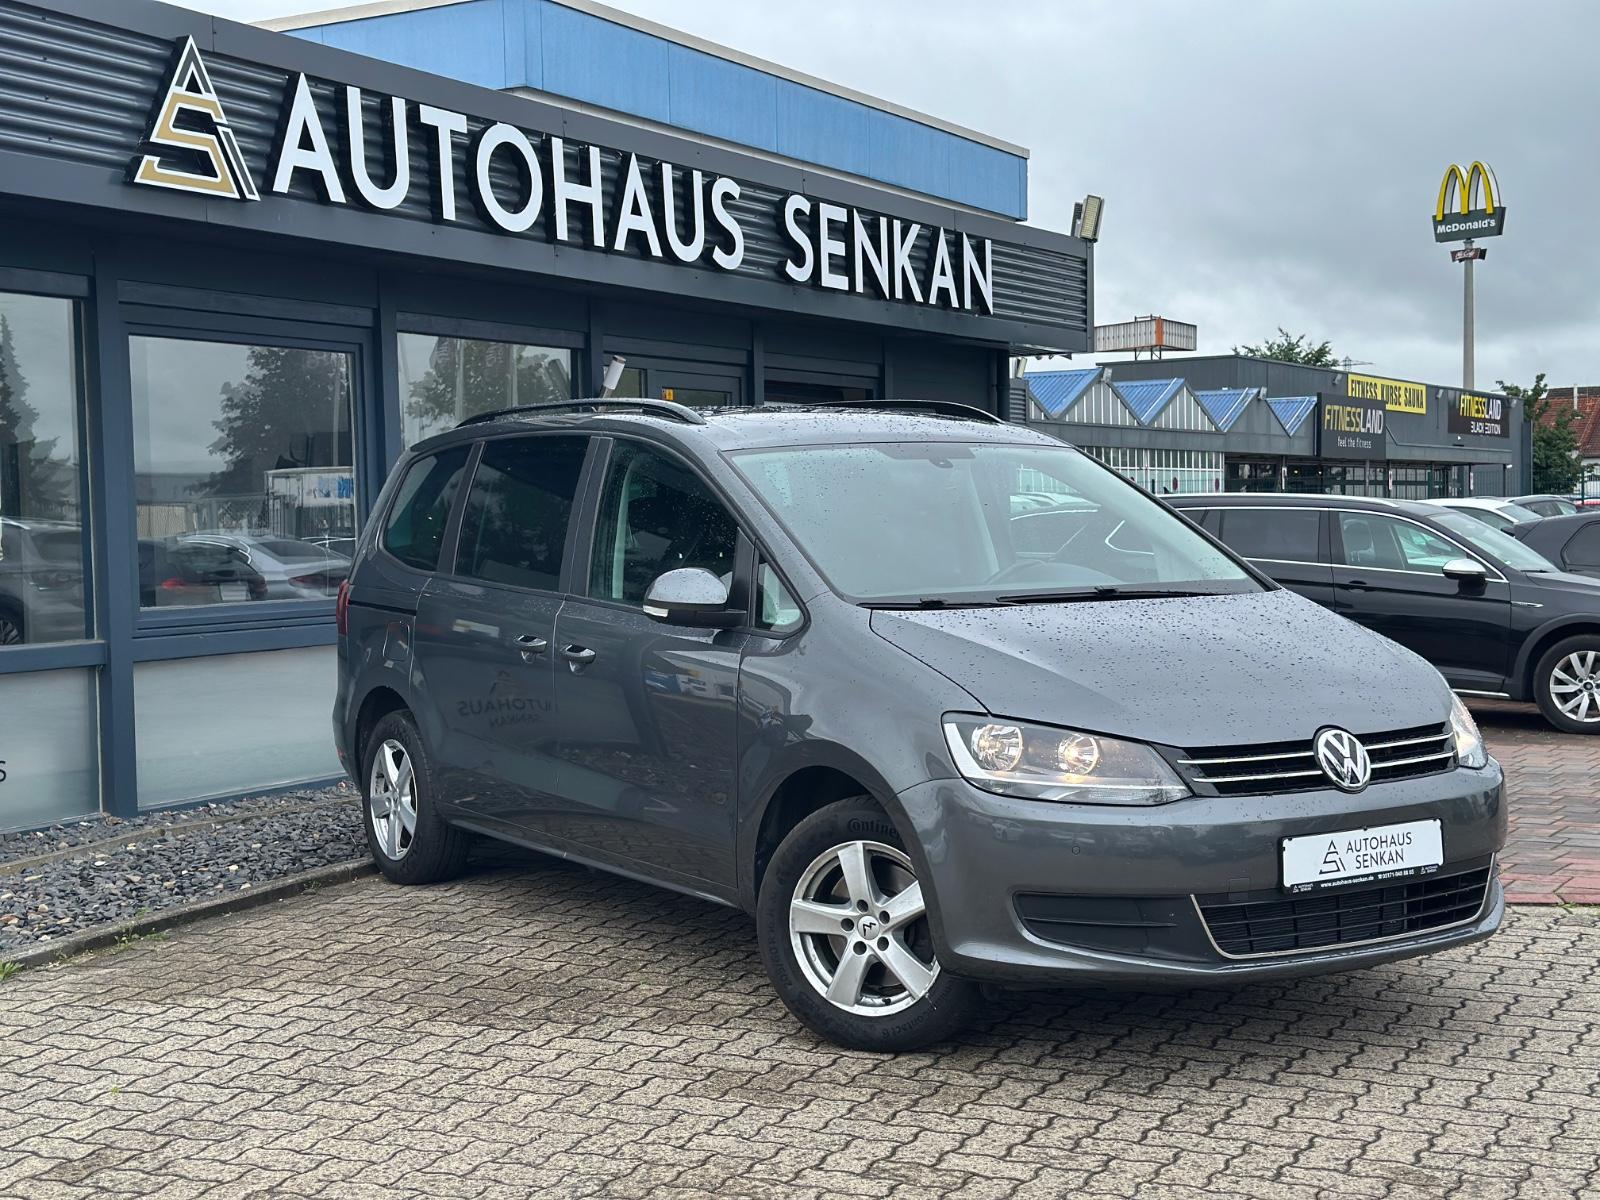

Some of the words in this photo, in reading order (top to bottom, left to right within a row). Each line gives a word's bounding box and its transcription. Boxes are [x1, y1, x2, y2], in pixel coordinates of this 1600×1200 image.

[273, 72, 745, 270] AUTOHAUS
[784, 194, 994, 316] SENKAN
[1436, 219, 1496, 234] McDonald's
[1350, 379, 1378, 400] FITNESS
[1380, 384, 1402, 406] KURSE
[1403, 386, 1424, 409] SAUNA
[1460, 394, 1502, 420] FITNESSLAND
[1324, 404, 1384, 434] FITNESSLAND
[1346, 832, 1412, 855] AUTOHAUS
[1355, 848, 1404, 870] SENKAN
